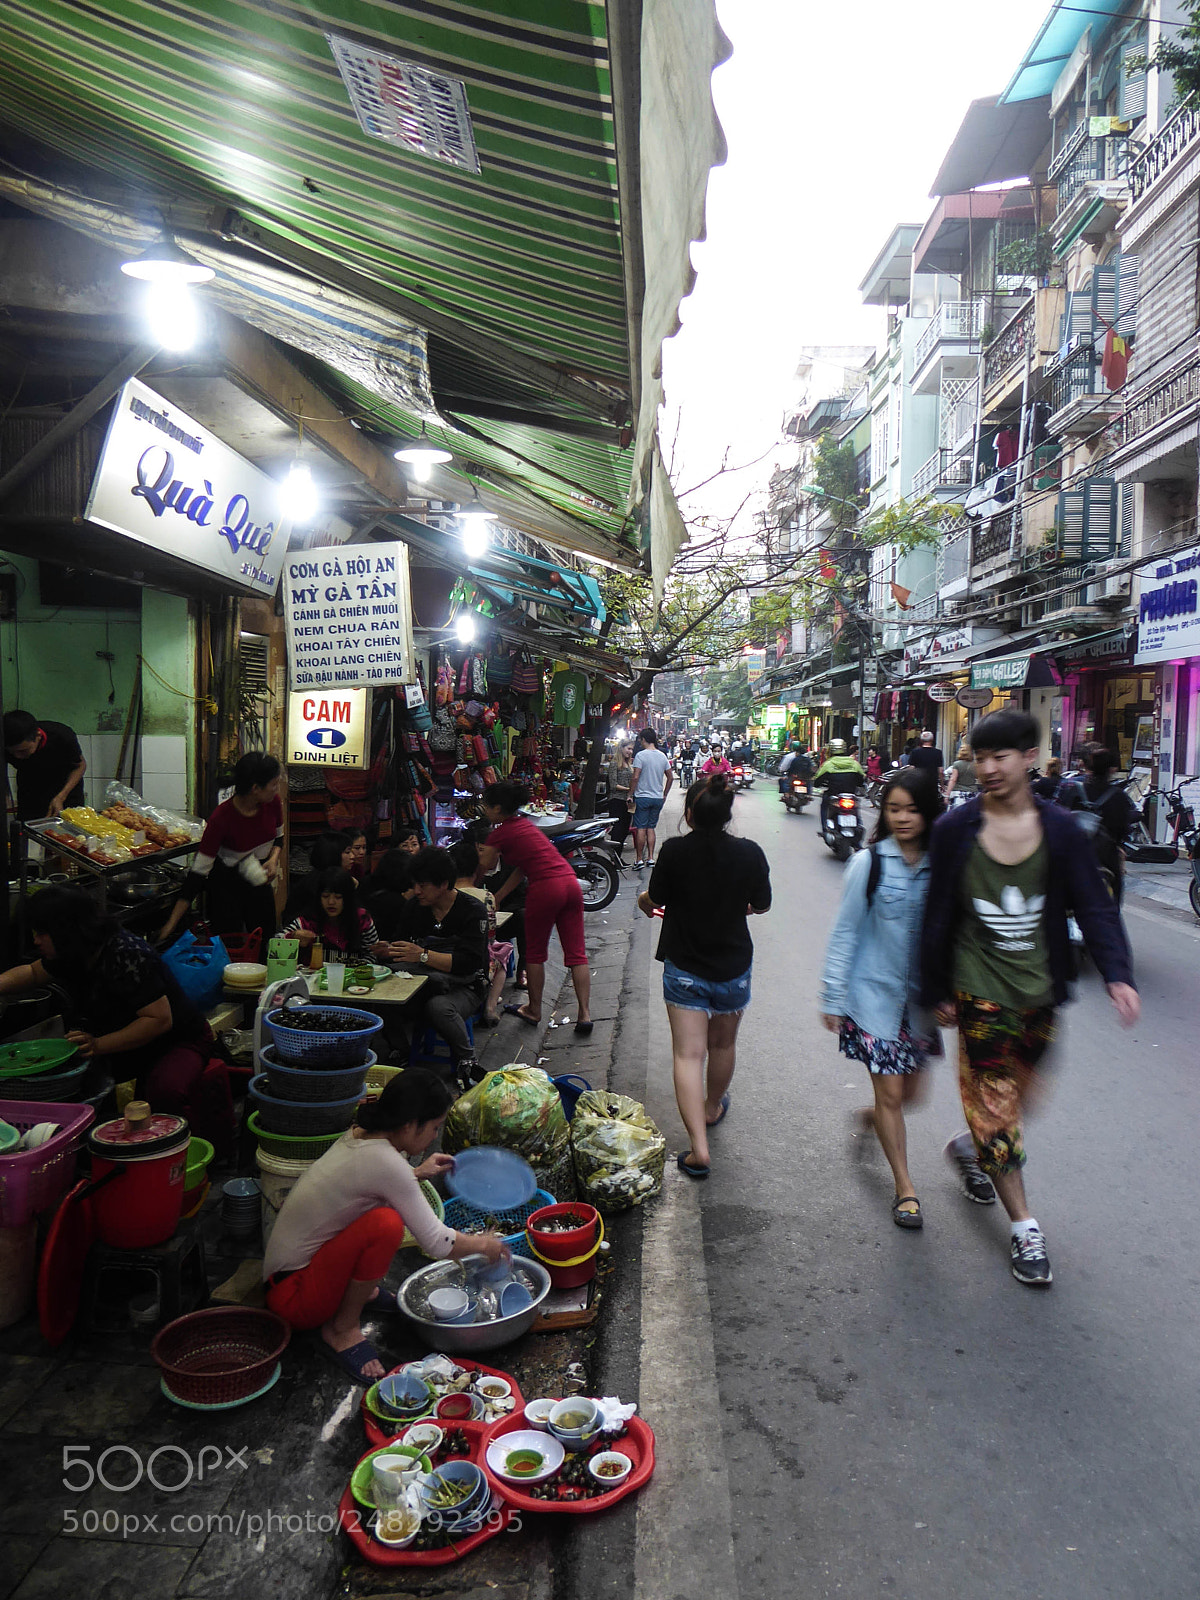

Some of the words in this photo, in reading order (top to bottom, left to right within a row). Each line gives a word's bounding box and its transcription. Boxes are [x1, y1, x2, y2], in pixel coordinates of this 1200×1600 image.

[131, 445, 214, 527] Quà
[218, 494, 274, 556] Quê
[290, 562, 319, 579] CƠM
[323, 557, 343, 577] GÀ
[346, 555, 371, 578] HỘI
[375, 557, 395, 573] AN
[292, 584, 319, 604] MỲ
[325, 582, 352, 601] GÀ
[356, 576, 396, 600] TẦN
[324, 606, 336, 619] GÀ
[340, 605, 369, 617] CHIÊN
[372, 601, 398, 615] MUỐI
[294, 626, 324, 636] NEM
[328, 623, 366, 634] CHUA
[371, 619, 399, 631] RÁN
[295, 641, 333, 652] KHOAI
[336, 638, 361, 648] TÂY
[364, 635, 400, 647] CHIÊN
[296, 657, 331, 668] KHOAI
[334, 654, 365, 665] LANG
[368, 650, 401, 663] CHIÊN
[296, 670, 313, 684] SỮA
[316, 669, 332, 684] ĐẬU
[335, 668, 358, 681] NÀNH
[367, 666, 383, 678] TÀO
[385, 664, 403, 677] PHỚ
[303, 699, 351, 724] CAM
[317, 730, 337, 746] 1
[294, 751, 327, 762] ĐINH
[331, 751, 359, 766] LIỆT
